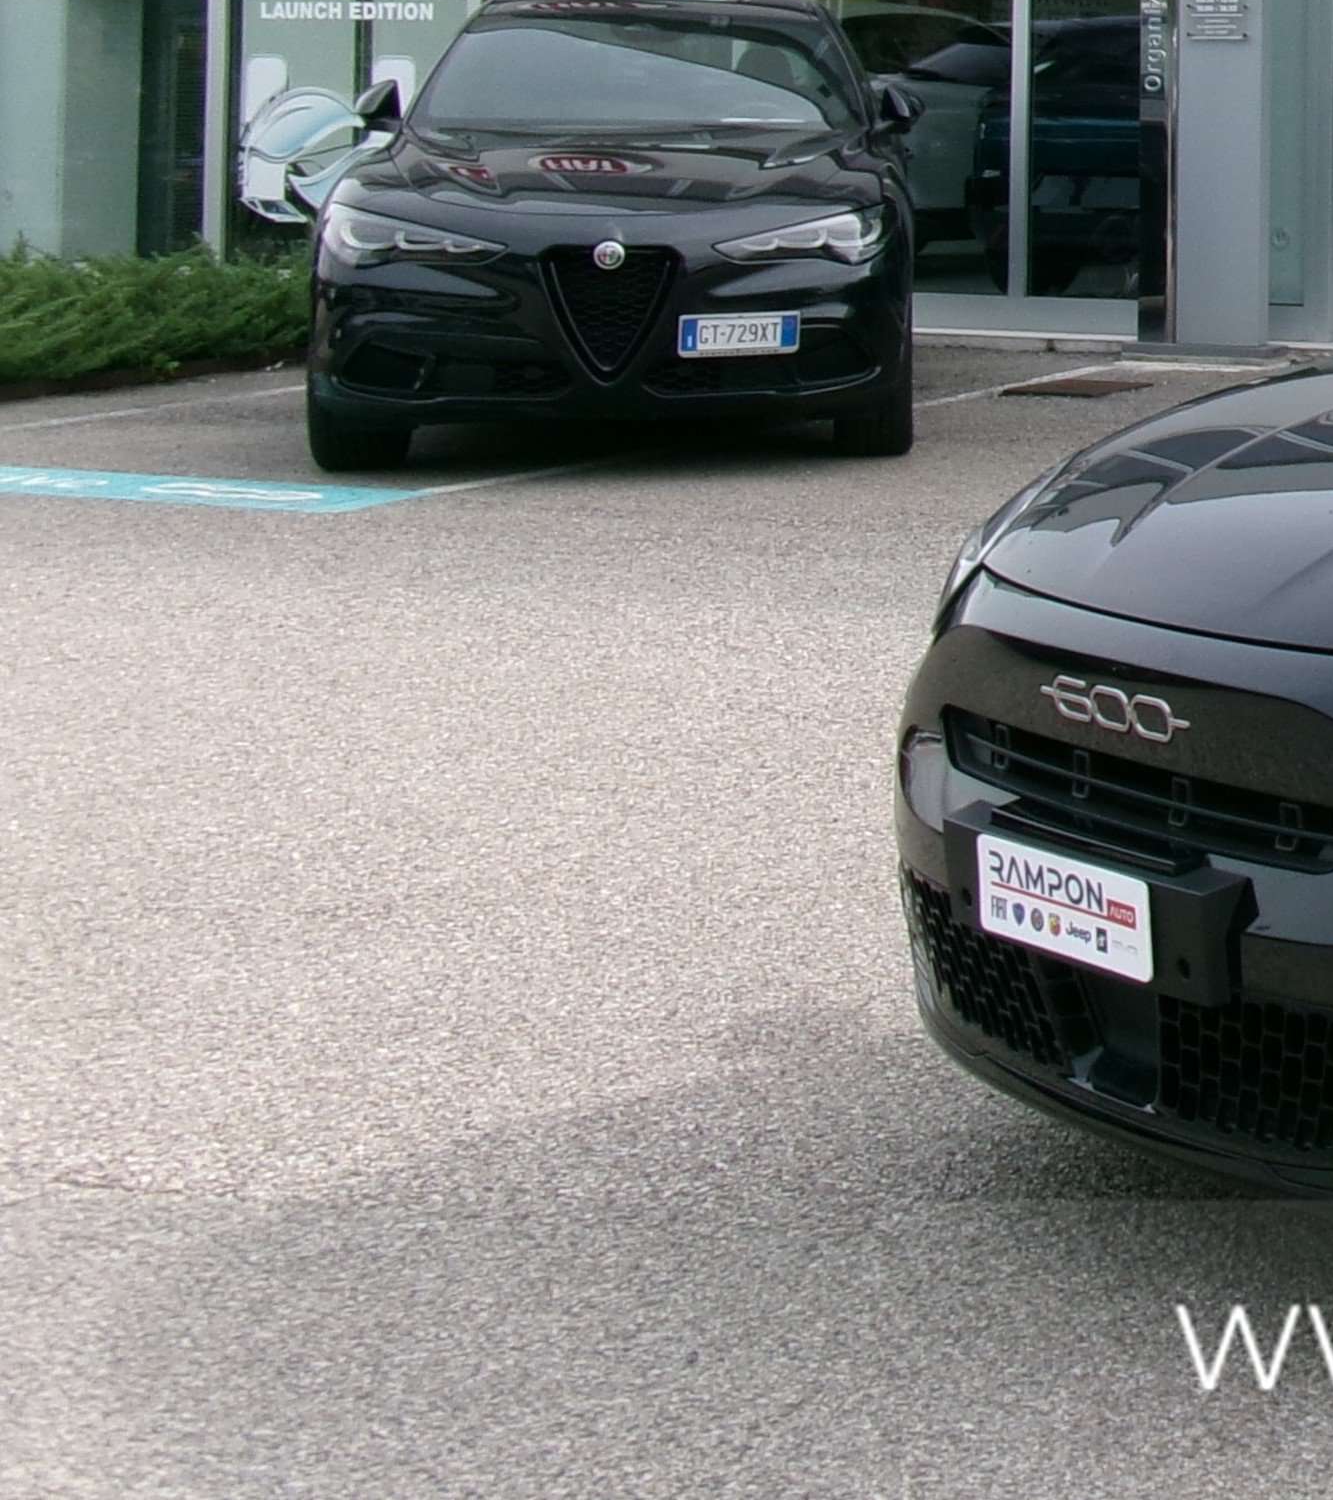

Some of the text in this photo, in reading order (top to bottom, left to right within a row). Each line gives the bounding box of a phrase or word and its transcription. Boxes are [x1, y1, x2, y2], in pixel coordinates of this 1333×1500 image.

[260, 2, 435, 21] LAUNCH EDITION
[1040, 674, 1190, 743] 600
[989, 851, 1135, 923] RAMPON AUTO
[1065, 920, 1092, 945] Jeep
